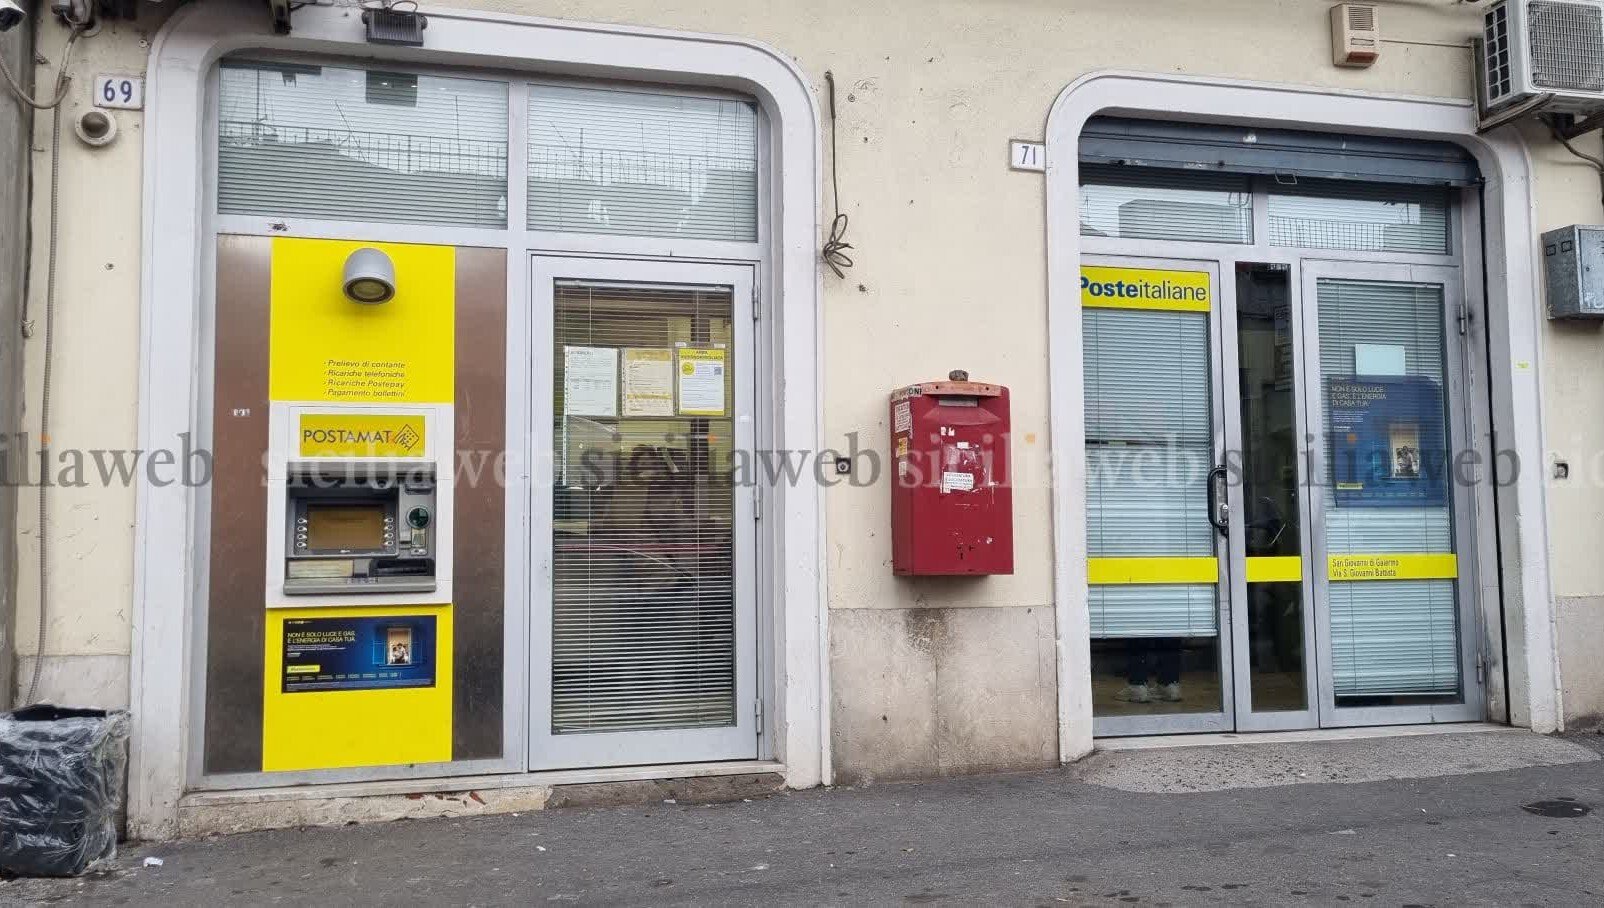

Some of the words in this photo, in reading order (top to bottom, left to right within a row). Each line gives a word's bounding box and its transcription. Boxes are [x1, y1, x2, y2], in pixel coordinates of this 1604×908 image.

[103, 79, 132, 103] 69
[1021, 145, 1036, 165] 71
[328, 360, 360, 368] Prelievo
[328, 379, 366, 387] Ricariche
[367, 380, 406, 389] Postepay
[328, 389, 371, 398] Pagamento
[303, 429, 394, 444] POSTAMAT
[1332, 558, 1343, 567] San
[1344, 558, 1369, 567] Giovanni
[1369, 558, 1375, 567] di
[1332, 569, 1342, 577] Via
[1349, 569, 1374, 577] Giovanni
[1375, 569, 1397, 577] Battista
